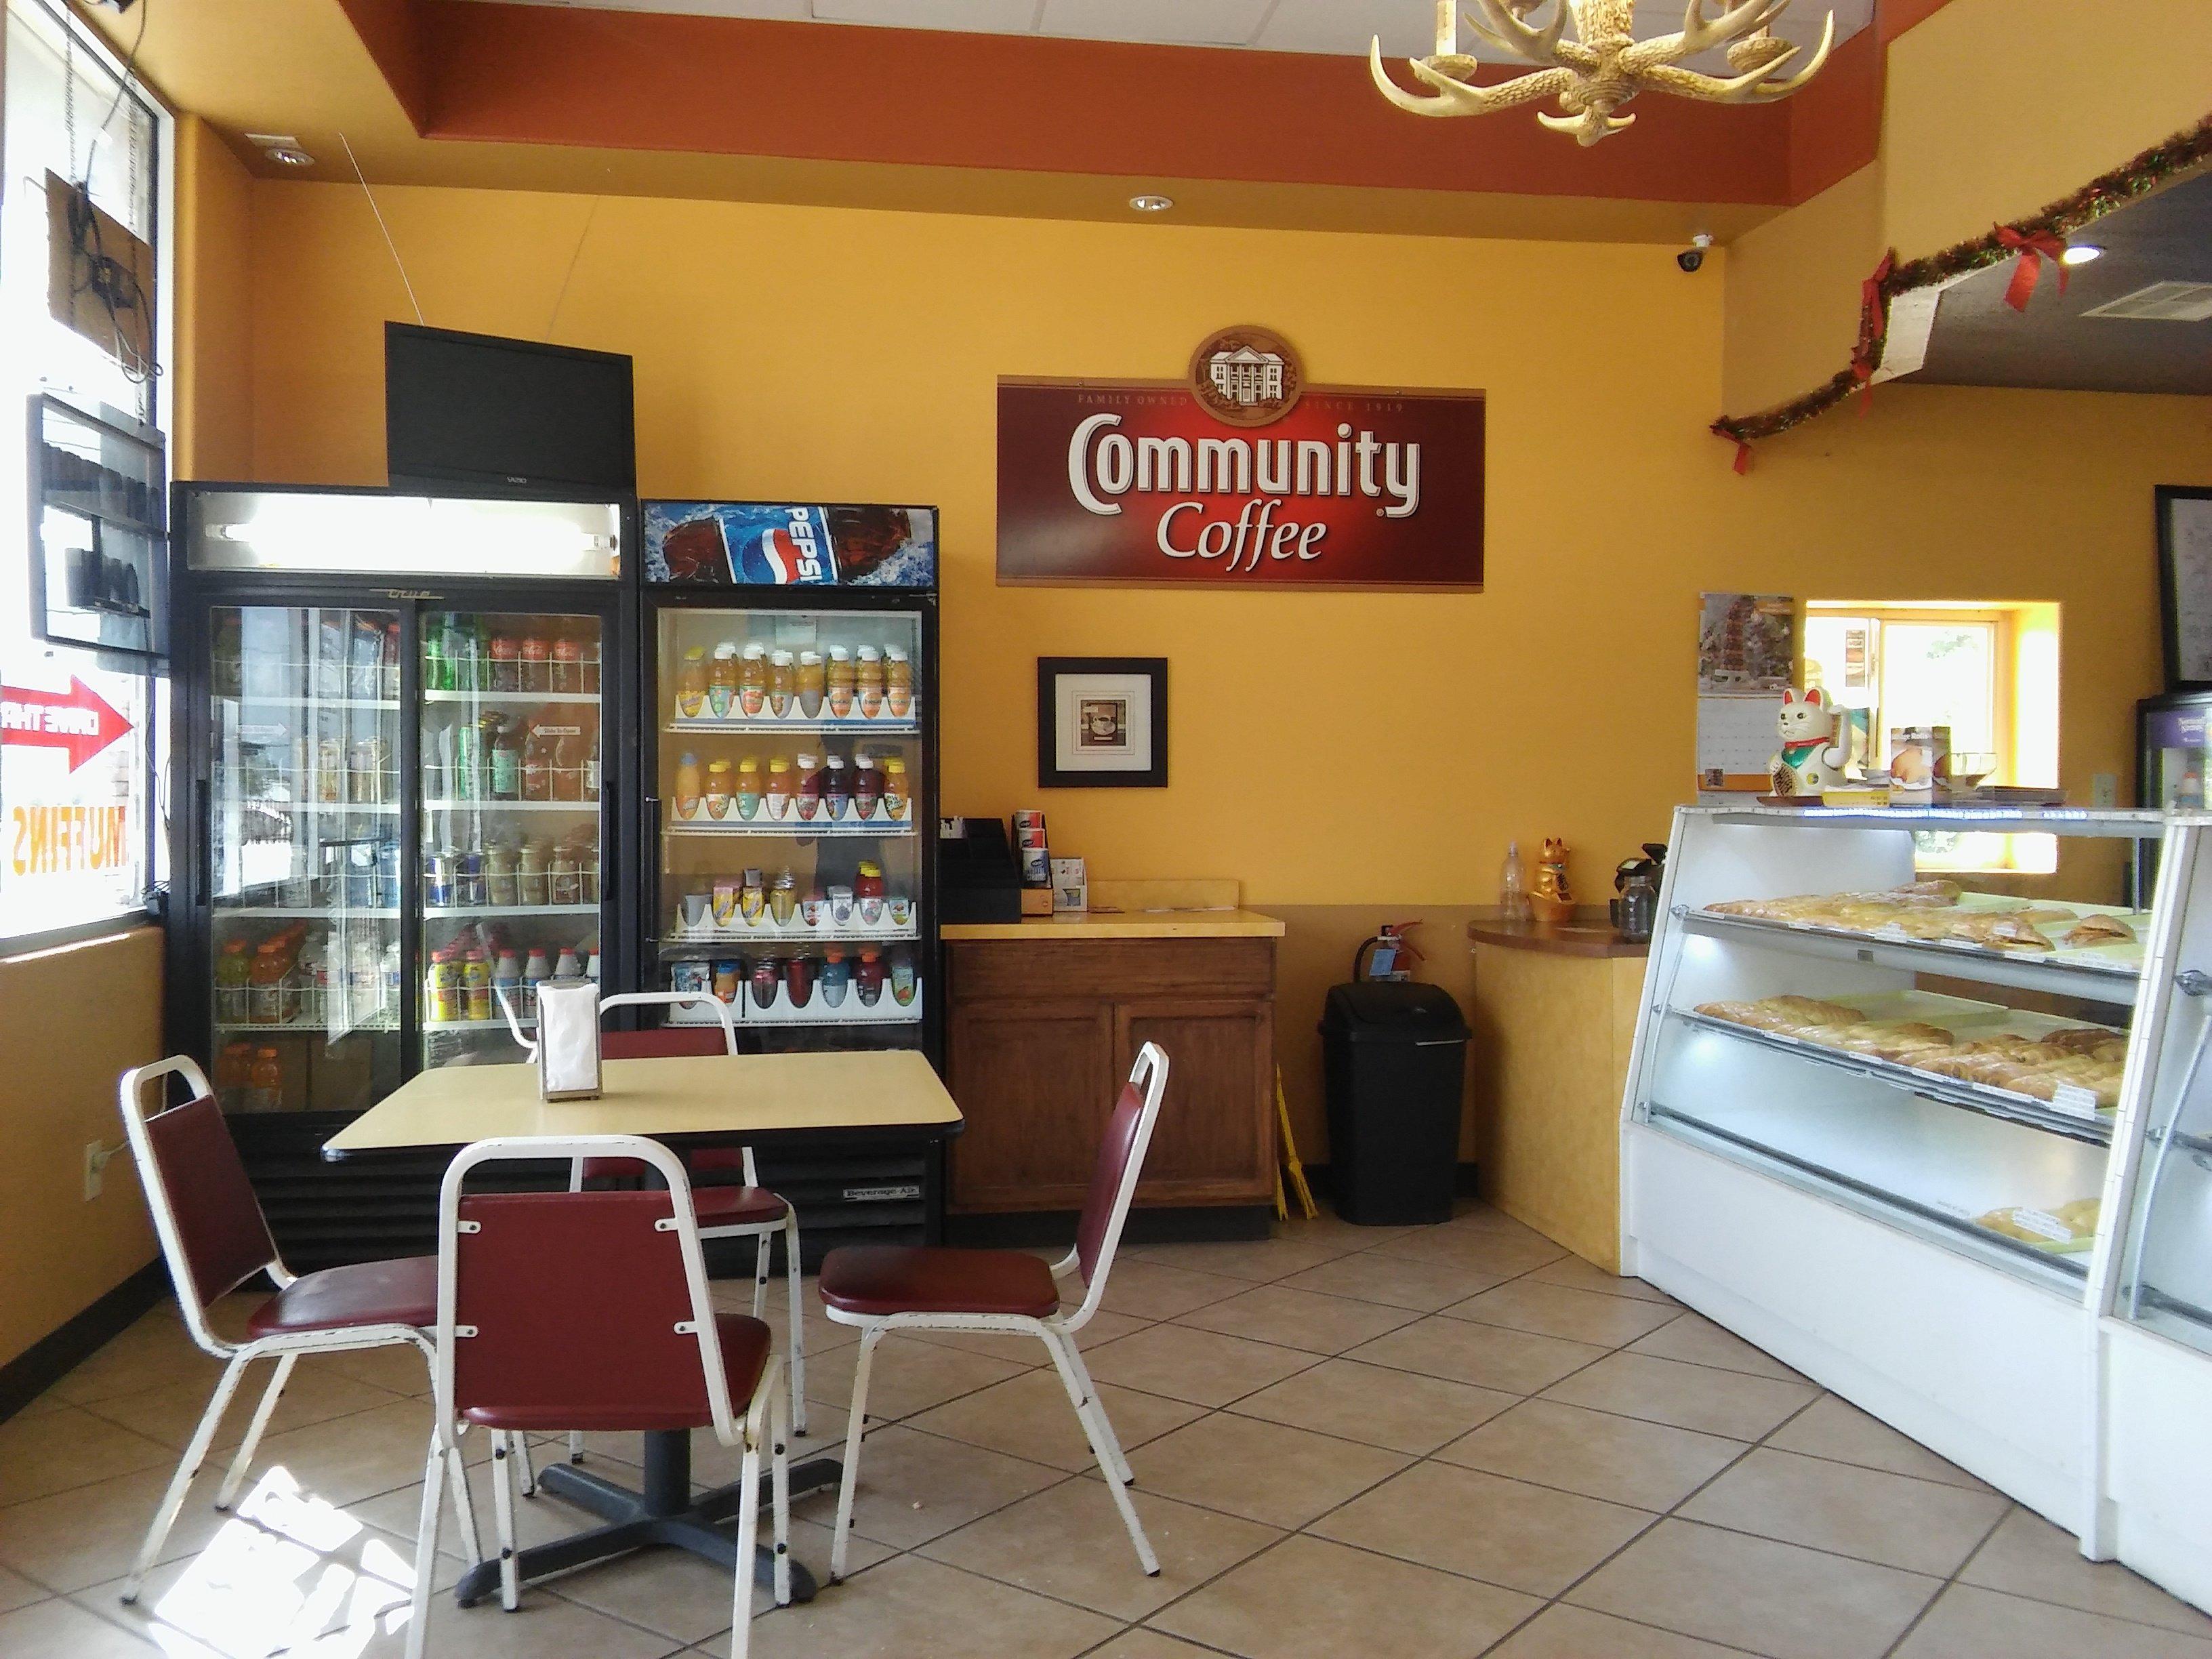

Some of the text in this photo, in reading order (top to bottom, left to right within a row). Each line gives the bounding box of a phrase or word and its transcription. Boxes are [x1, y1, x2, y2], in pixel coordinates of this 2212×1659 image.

[1078, 394, 1187, 406] FAMILY OWNED
[1067, 412, 1420, 517] Community
[785, 507, 823, 581] PEPSI
[1156, 497, 1328, 573] Coffee
